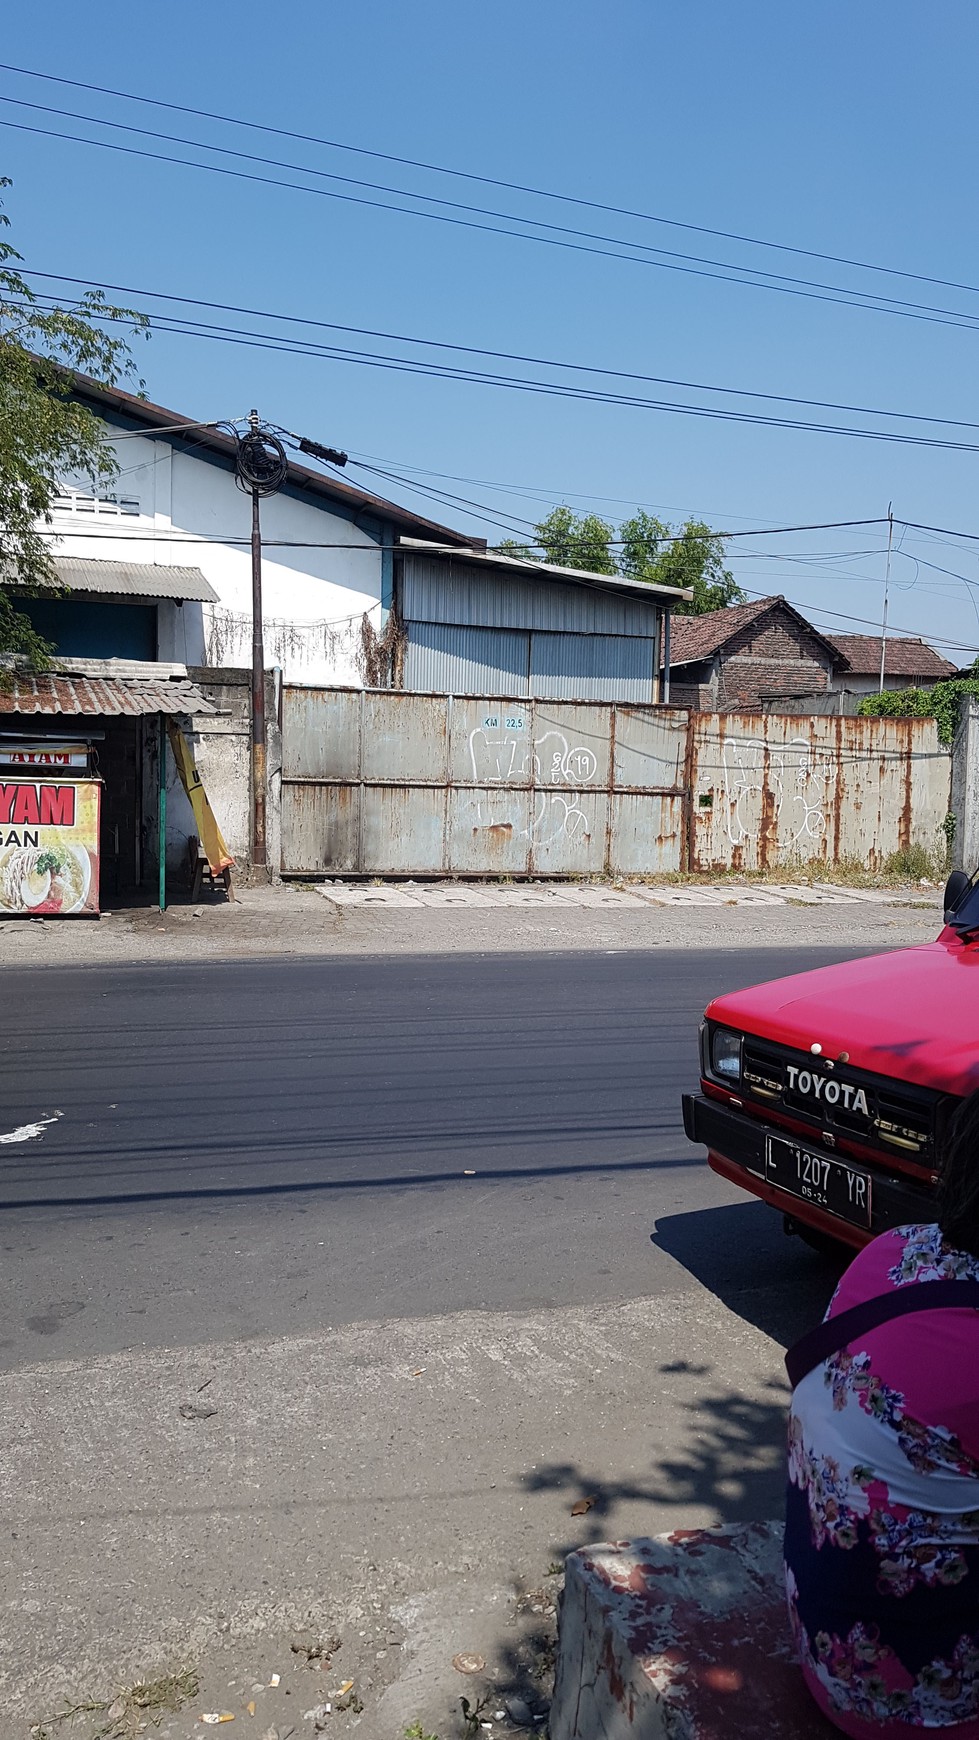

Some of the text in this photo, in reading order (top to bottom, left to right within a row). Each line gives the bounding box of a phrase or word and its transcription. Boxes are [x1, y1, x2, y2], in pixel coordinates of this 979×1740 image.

[484, 718, 523, 728] KM 22,5
[12, 753, 70, 765] AYAM
[0, 830, 39, 847] AN
[786, 1065, 869, 1116] TOYOTA
[768, 1138, 866, 1209] L 1207 YR
